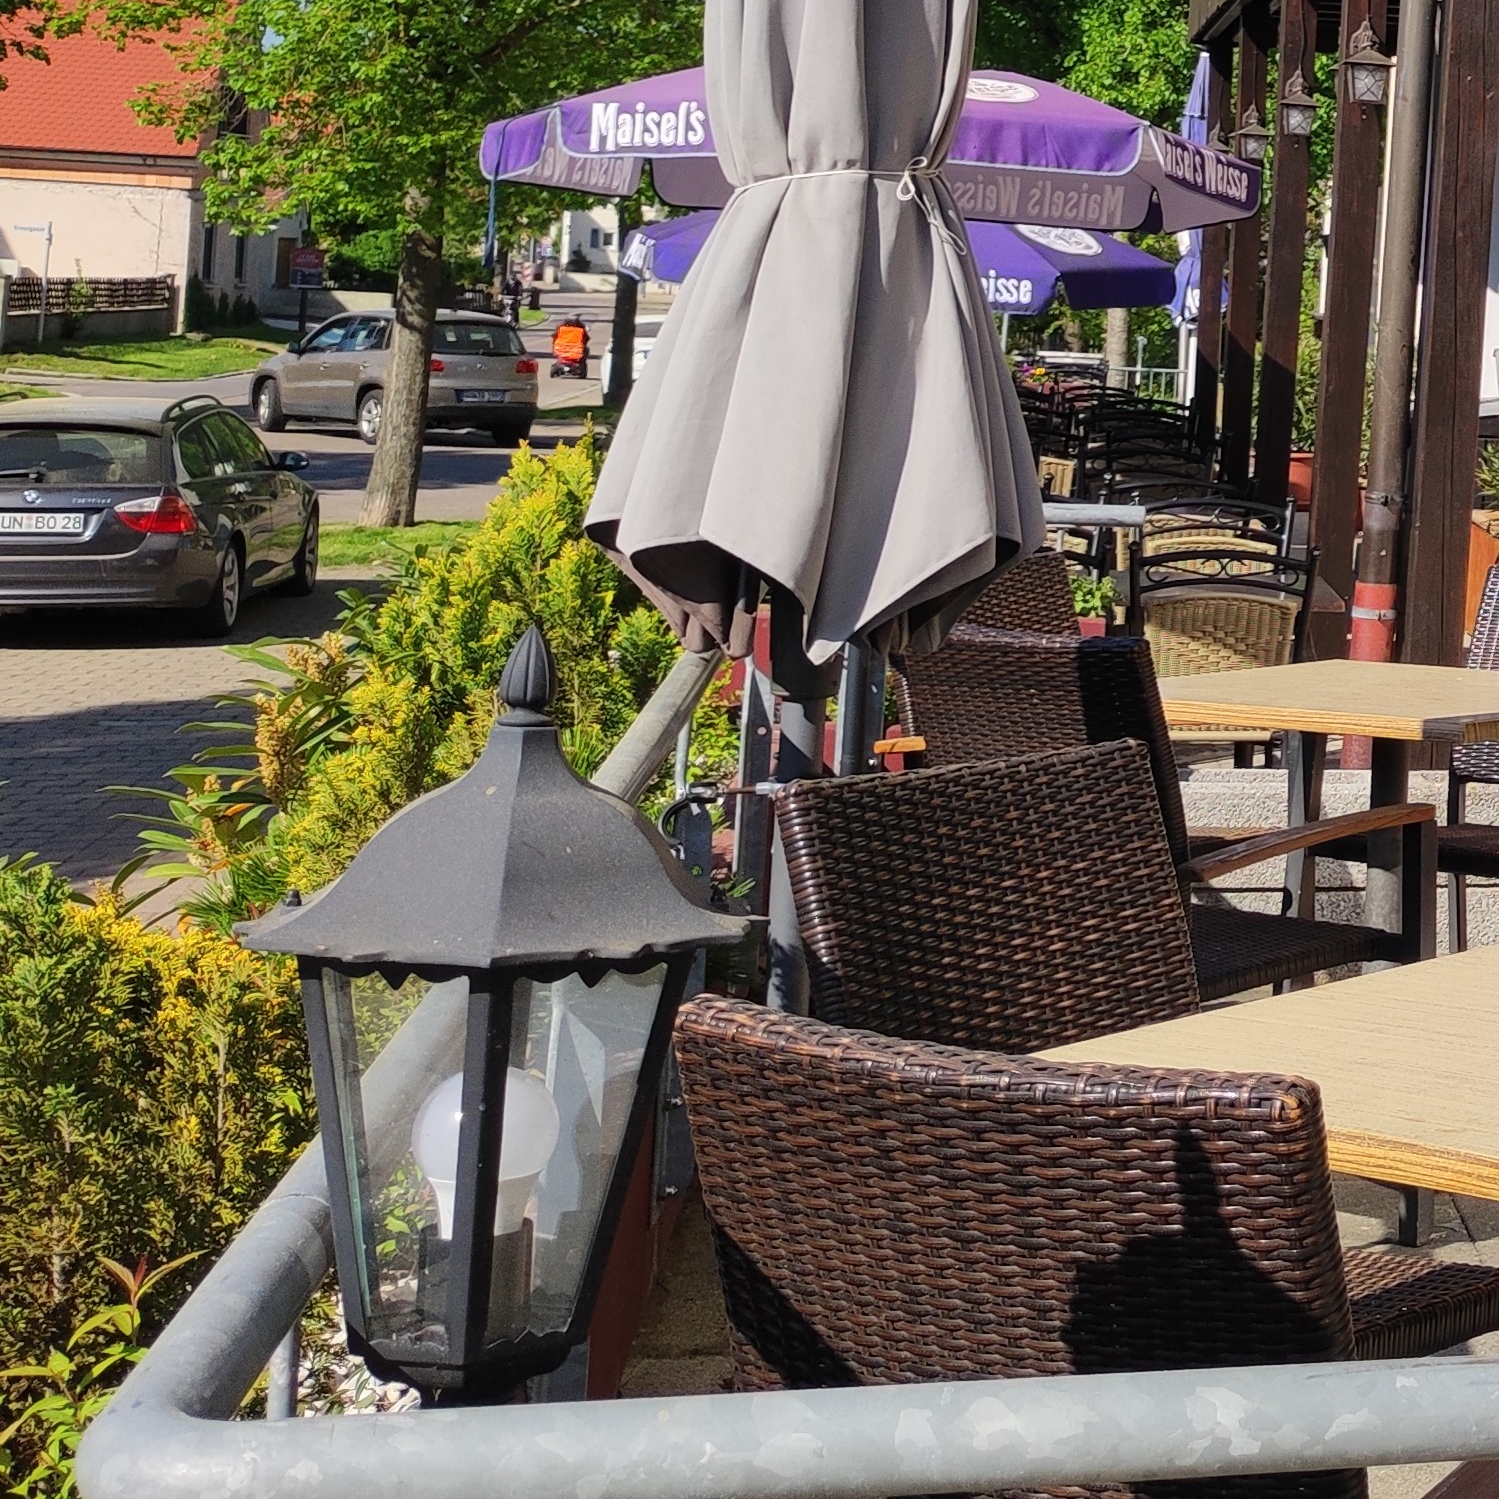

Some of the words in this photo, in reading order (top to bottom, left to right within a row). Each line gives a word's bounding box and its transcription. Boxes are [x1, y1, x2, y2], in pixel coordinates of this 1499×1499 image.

[589, 101, 706, 152] Maisel's
[1201, 148, 1249, 203] Weisse
[34, 515, 57, 530] BO
[61, 515, 82, 530] 28
